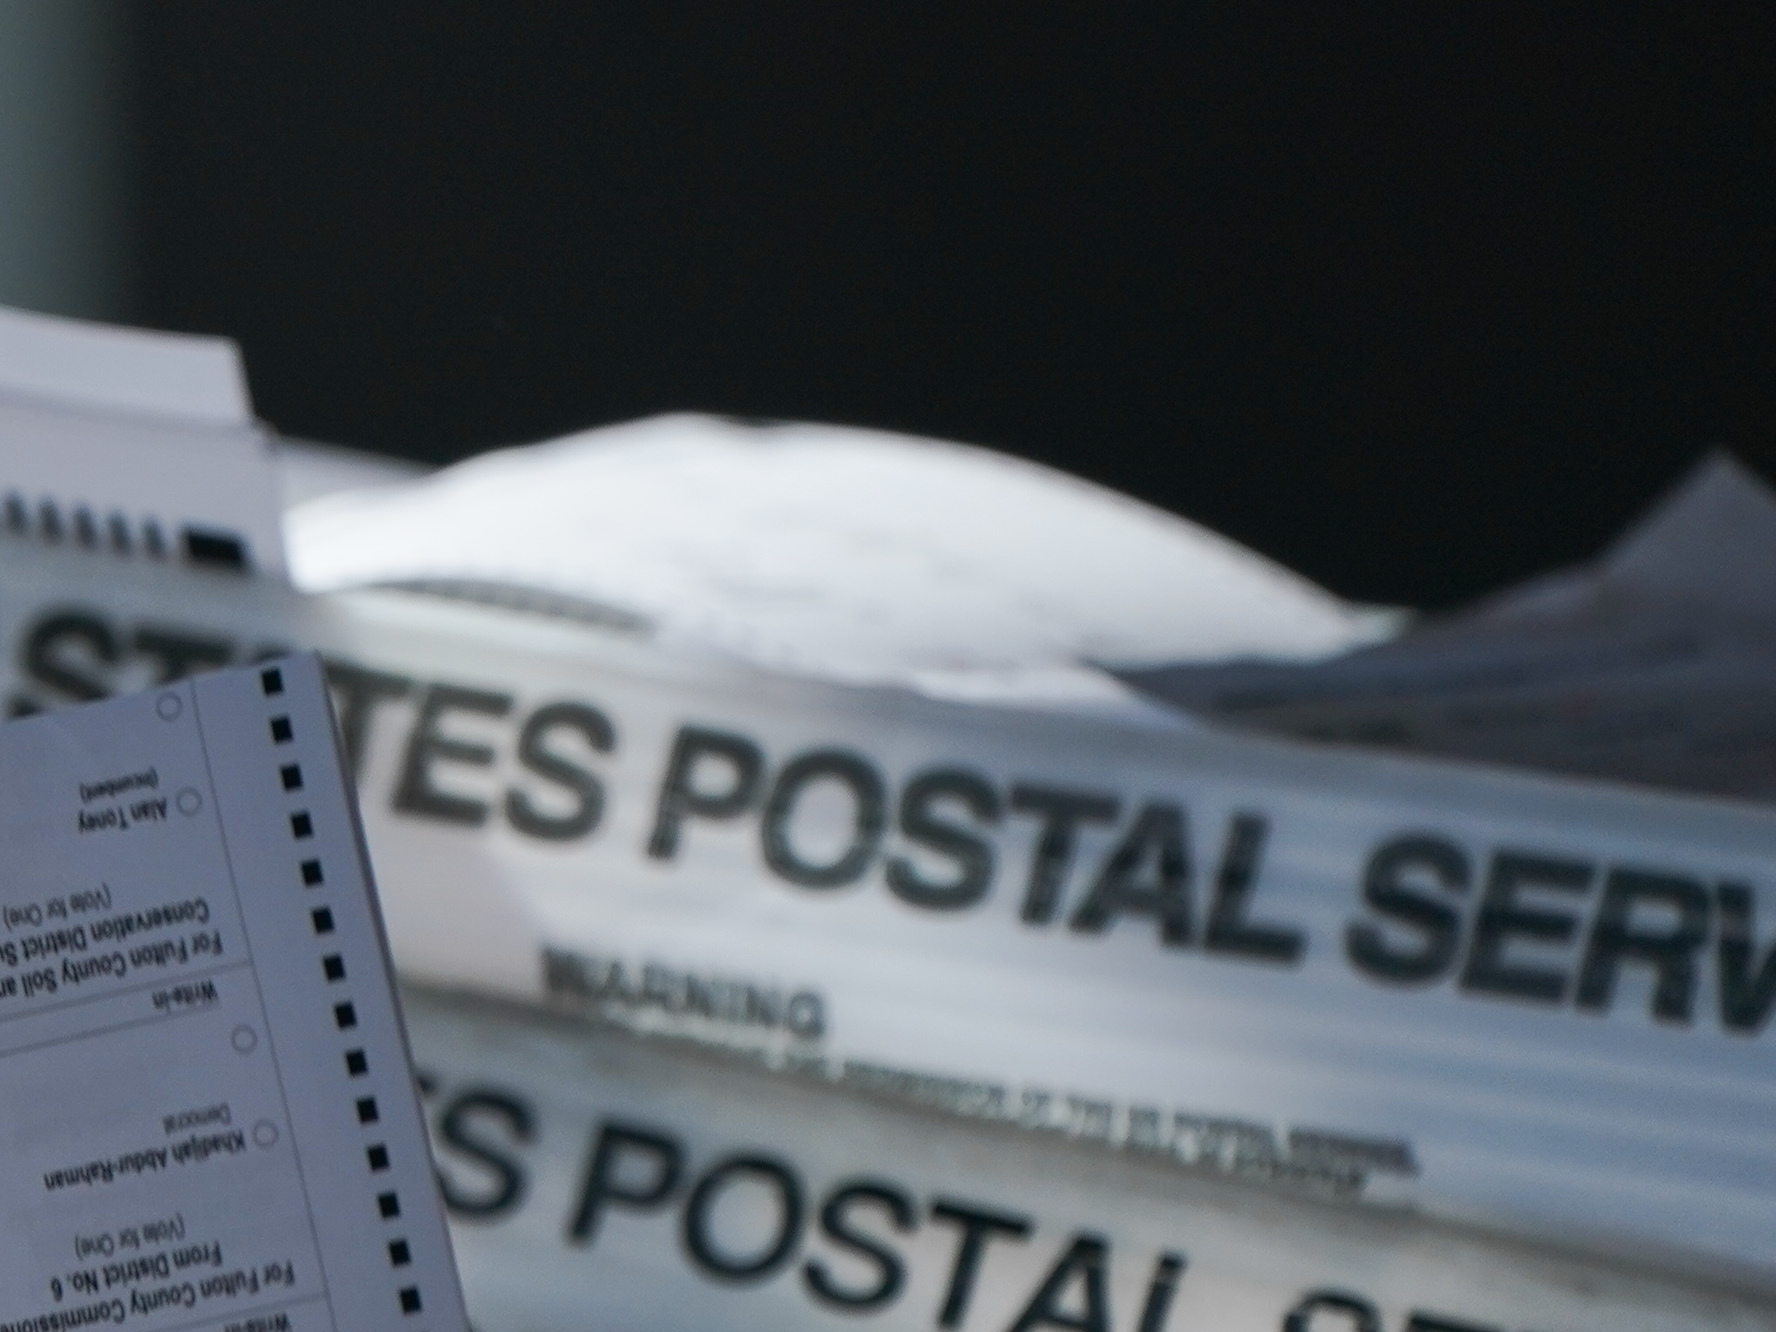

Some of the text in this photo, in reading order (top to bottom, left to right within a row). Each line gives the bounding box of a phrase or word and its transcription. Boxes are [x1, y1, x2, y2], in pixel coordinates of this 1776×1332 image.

[2, 602, 618, 844] STES
[642, 720, 1310, 970] POSTAL
[77, 797, 168, 833] Alan Toney
[89, 897, 210, 943] Conservation
[20, 925, 88, 962] District
[128, 937, 189, 969] Fulton
[191, 930, 224, 956] For
[20, 967, 58, 998] Soil
[61, 951, 127, 985] County
[540, 940, 828, 1042] WARNING
[50, 1240, 223, 1302] From District No. 6
[199, 1268, 260, 1299] Fulton
[263, 1260, 296, 1287] For
[130, 1281, 197, 1316] County
